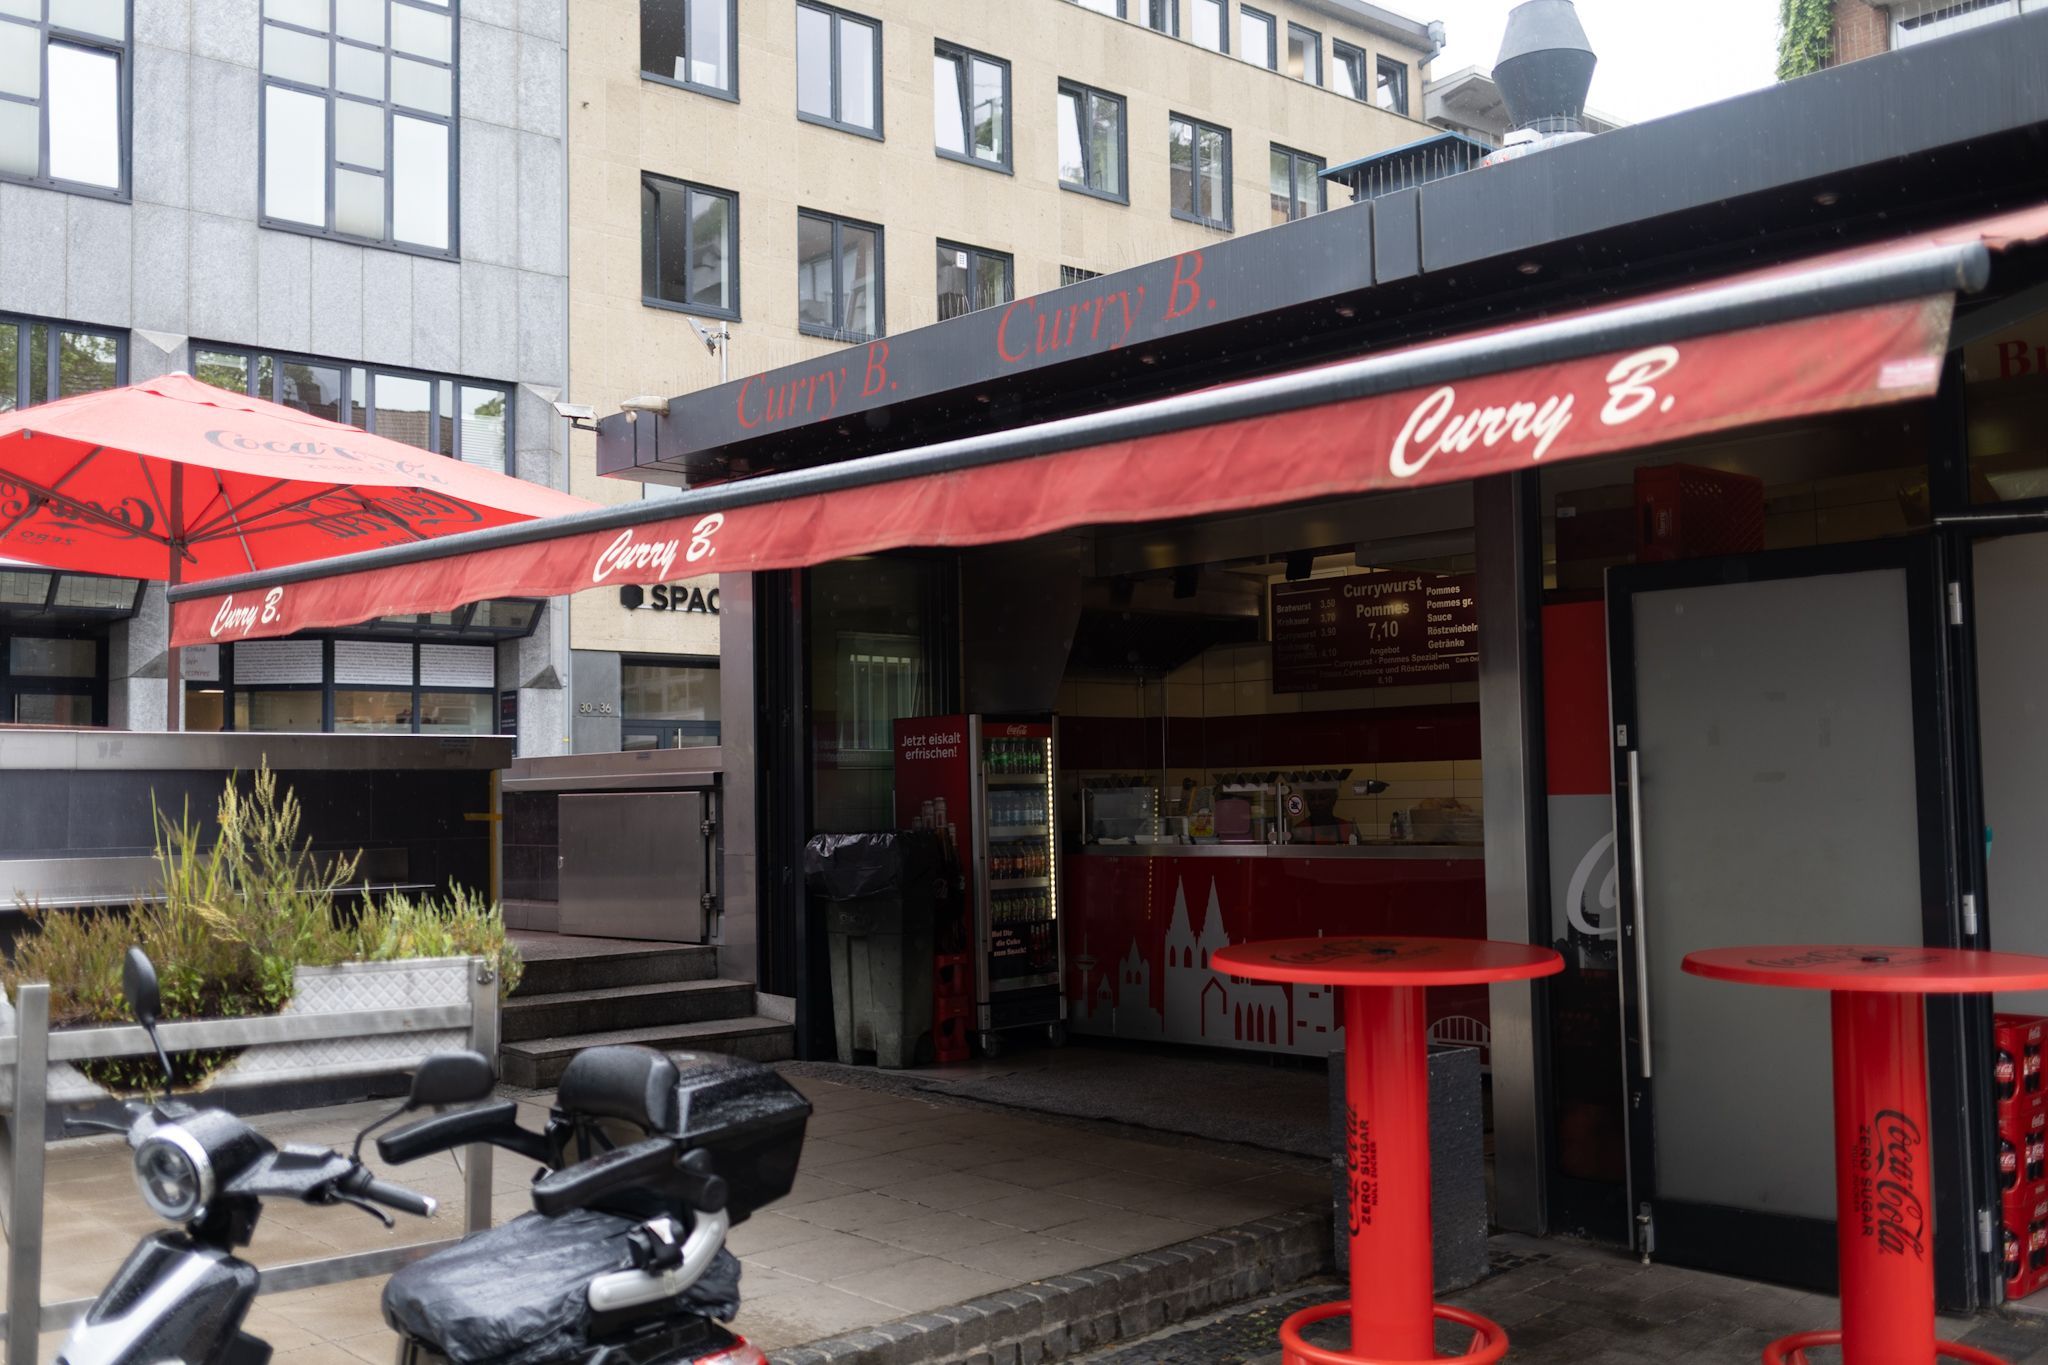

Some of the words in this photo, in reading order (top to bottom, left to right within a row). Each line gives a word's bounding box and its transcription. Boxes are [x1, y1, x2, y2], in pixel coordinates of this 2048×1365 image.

[997, 283, 1147, 364] Curry
[1163, 251, 1217, 321] B.
[737, 368, 846, 430] Curry
[861, 341, 898, 399] B.
[1389, 386, 1574, 477] Curry
[1600, 345, 1680, 426] B.
[593, 528, 679, 583] Curry
[686, 513, 724, 562] B.
[1343, 576, 1422, 599] Currywurst
[1426, 585, 1461, 596] Pommes
[210, 594, 259, 637] Curry
[261, 586, 283, 624] B.
[1356, 602, 1410, 619] Pommes
[1426, 599, 1461, 609] Pommes
[1427, 612, 1453, 623] Sauce
[1368, 620, 1399, 641] 7,10
[1370, 646, 1401, 657] Angebot
[1427, 638, 1466, 650] Getränke
[1411, 652, 1439, 664] Spezial
[901, 735, 926, 748] Jetzt
[928, 732, 961, 746] eiskalt
[905, 746, 958, 760] erfrischen!
[1359, 1119, 1370, 1176] SUGAR
[1859, 1122, 1872, 1172] ZERO
[1360, 1181, 1371, 1226] ZERO
[1860, 1179, 1874, 1238] SUGAR
